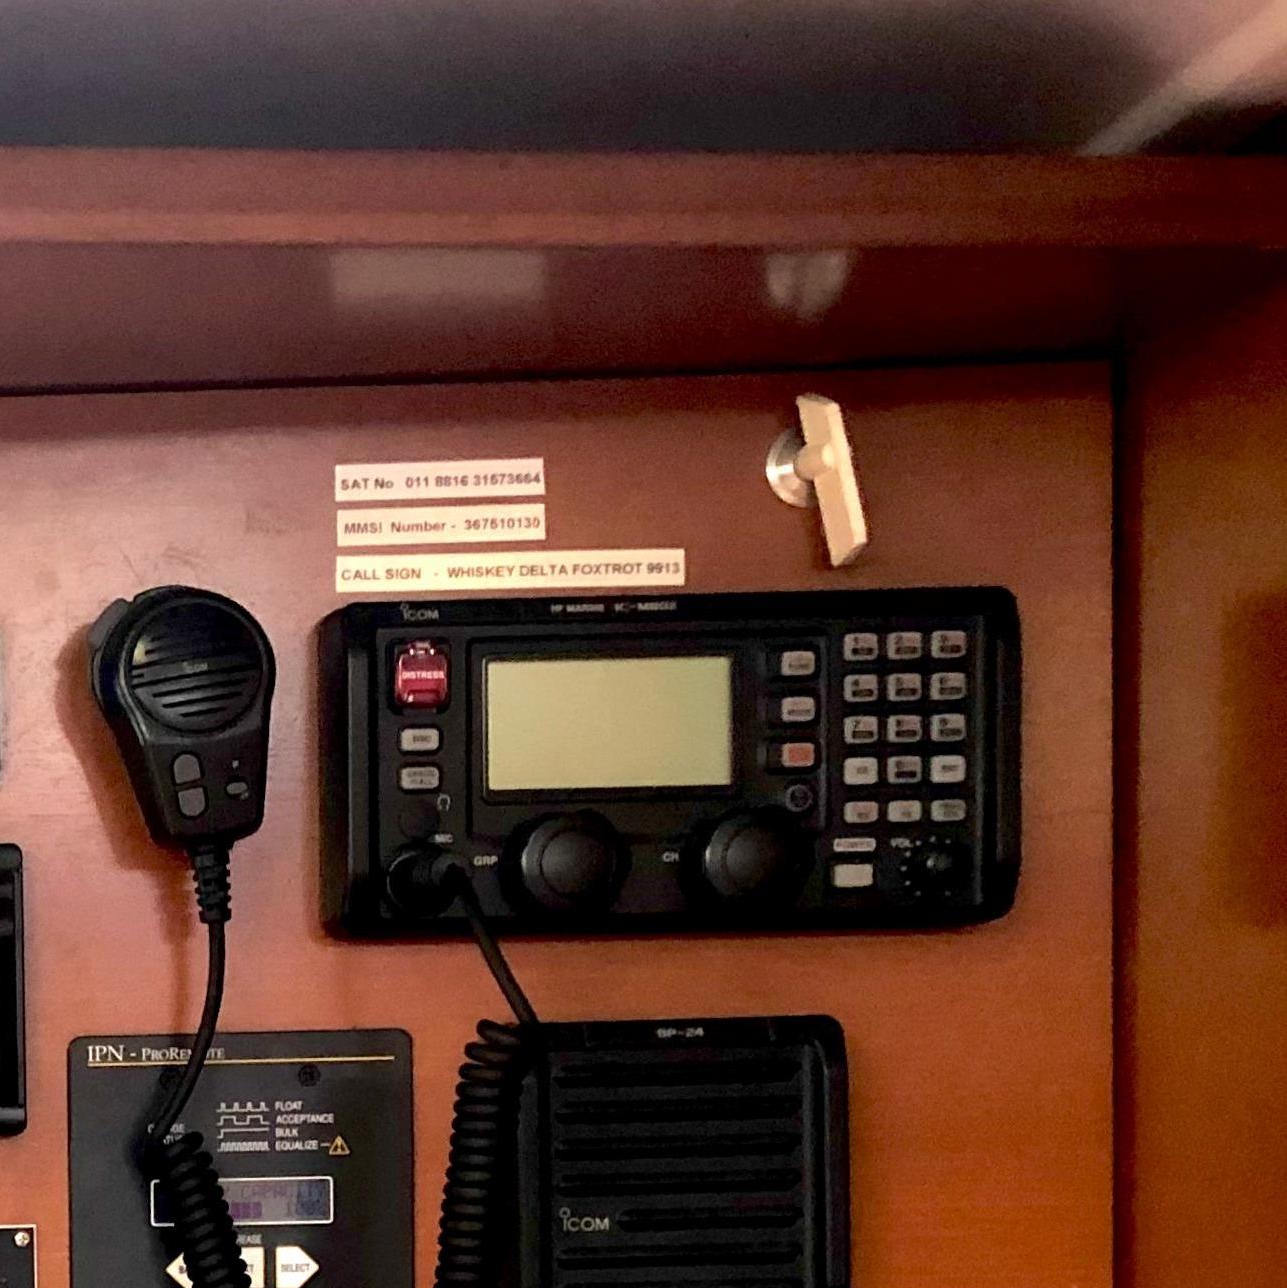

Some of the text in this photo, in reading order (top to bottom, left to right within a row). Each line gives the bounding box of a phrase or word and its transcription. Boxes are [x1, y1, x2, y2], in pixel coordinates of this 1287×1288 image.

[340, 478, 368, 491] SAT
[374, 478, 394, 490] No
[405, 476, 429, 488] 011
[391, 520, 445, 533] Number
[341, 568, 380, 581] CALL
[384, 568, 422, 580] SIGN
[447, 565, 515, 579] WHISKEY
[519, 563, 568, 577] DELTA
[572, 562, 642, 576] FOXTROT
[400, 670, 445, 680] DISTRESS
[474, 855, 498, 866] GRP
[87, 1044, 126, 1062] IPN
[275, 1101, 303, 1112] FLOAT
[275, 1113, 334, 1124] ACCEPTANCE
[275, 1128, 299, 1138] BULK
[275, 1140, 319, 1151] EQUALIZE
[280, 1262, 311, 1273] SELECT
